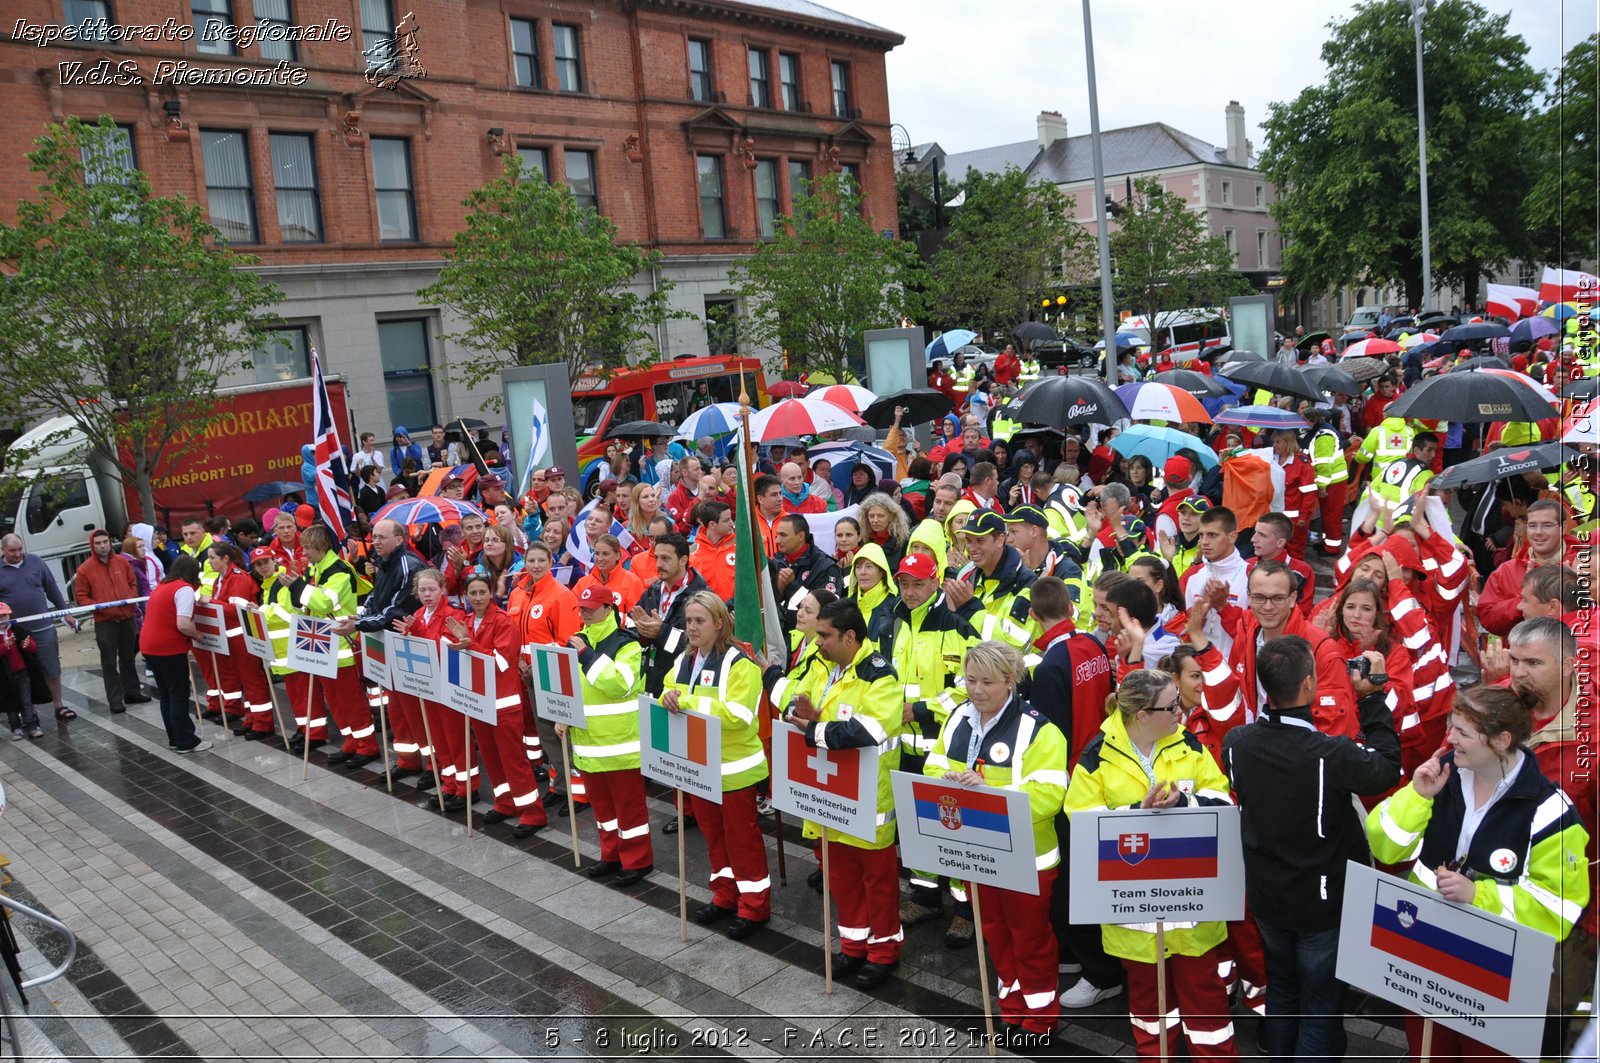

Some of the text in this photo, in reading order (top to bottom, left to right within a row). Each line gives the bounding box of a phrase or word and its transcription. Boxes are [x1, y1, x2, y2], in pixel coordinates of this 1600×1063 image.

[1068, 403, 1098, 419] Bass
[1497, 460, 1538, 474] LONDON
[1498, 455, 1510, 467] I
[150, 467, 226, 490] RANSPORT
[230, 463, 254, 477] LTD
[454, 689, 479, 704] Team France
[546, 696, 556, 705] Team
[469, 703, 483, 714] France
[547, 706, 557, 715] Team
[648, 764, 674, 779] Foireann
[659, 757, 699, 776] Team Ireland
[789, 786, 857, 815] Team Switzerland
[795, 801, 850, 826] Team Schweiz
[937, 845, 995, 863] Team Serbia
[938, 857, 971, 871] Србија
[1111, 886, 1204, 899] Team Slovakia
[1111, 901, 1204, 914] Tím Slovensko
[1387, 962, 1486, 1012] Team Slovenia
[1383, 976, 1486, 1029] Team Slovenija
